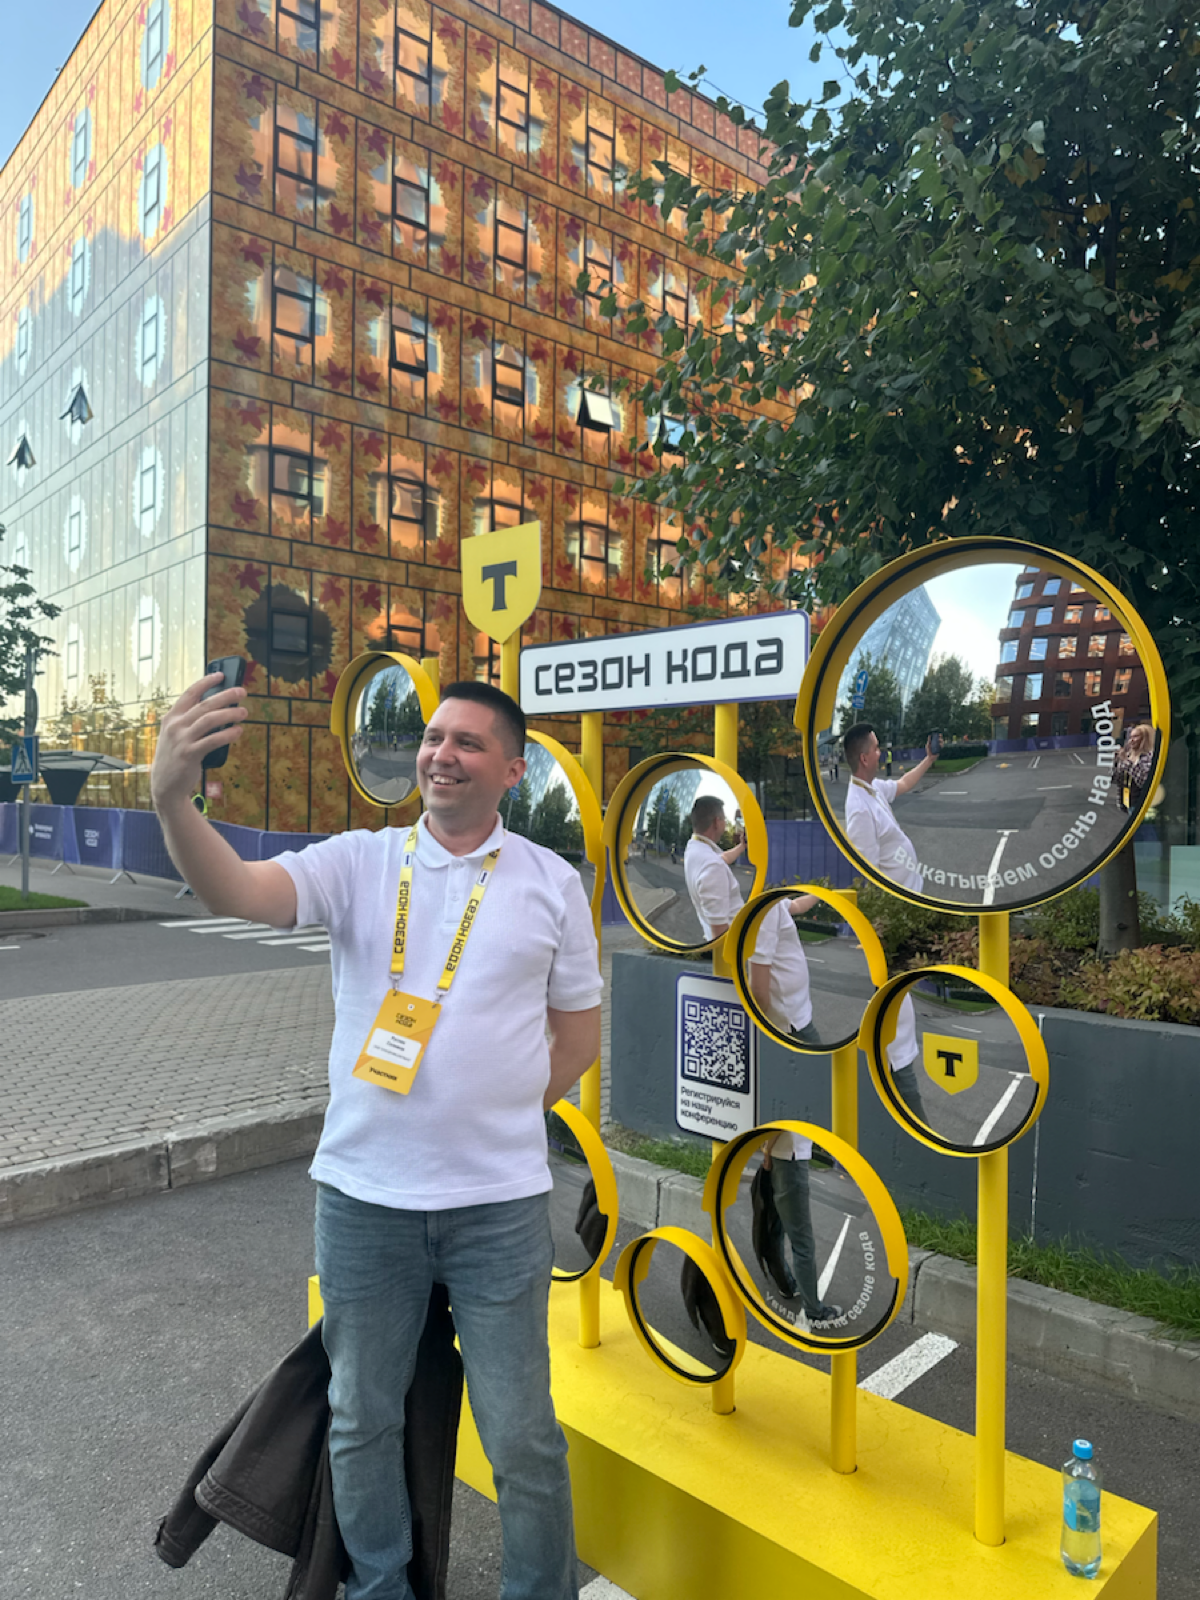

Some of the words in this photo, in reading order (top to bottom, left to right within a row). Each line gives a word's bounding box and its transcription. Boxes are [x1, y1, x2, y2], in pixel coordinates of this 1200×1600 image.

[535, 653, 650, 696] сезон
[666, 637, 784, 685] кода
[1091, 700, 1121, 767] прод
[1087, 774, 1112, 805] на
[1039, 811, 1097, 869] осень
[893, 845, 1038, 890] Выкатываем
[681, 1086, 741, 1109] Регистрируйся
[681, 1099, 690, 1107] на
[692, 1101, 712, 1115] нашу
[681, 1109, 738, 1131] конференцию
[859, 1231, 876, 1271] кода
[847, 1275, 876, 1320] сезоне
